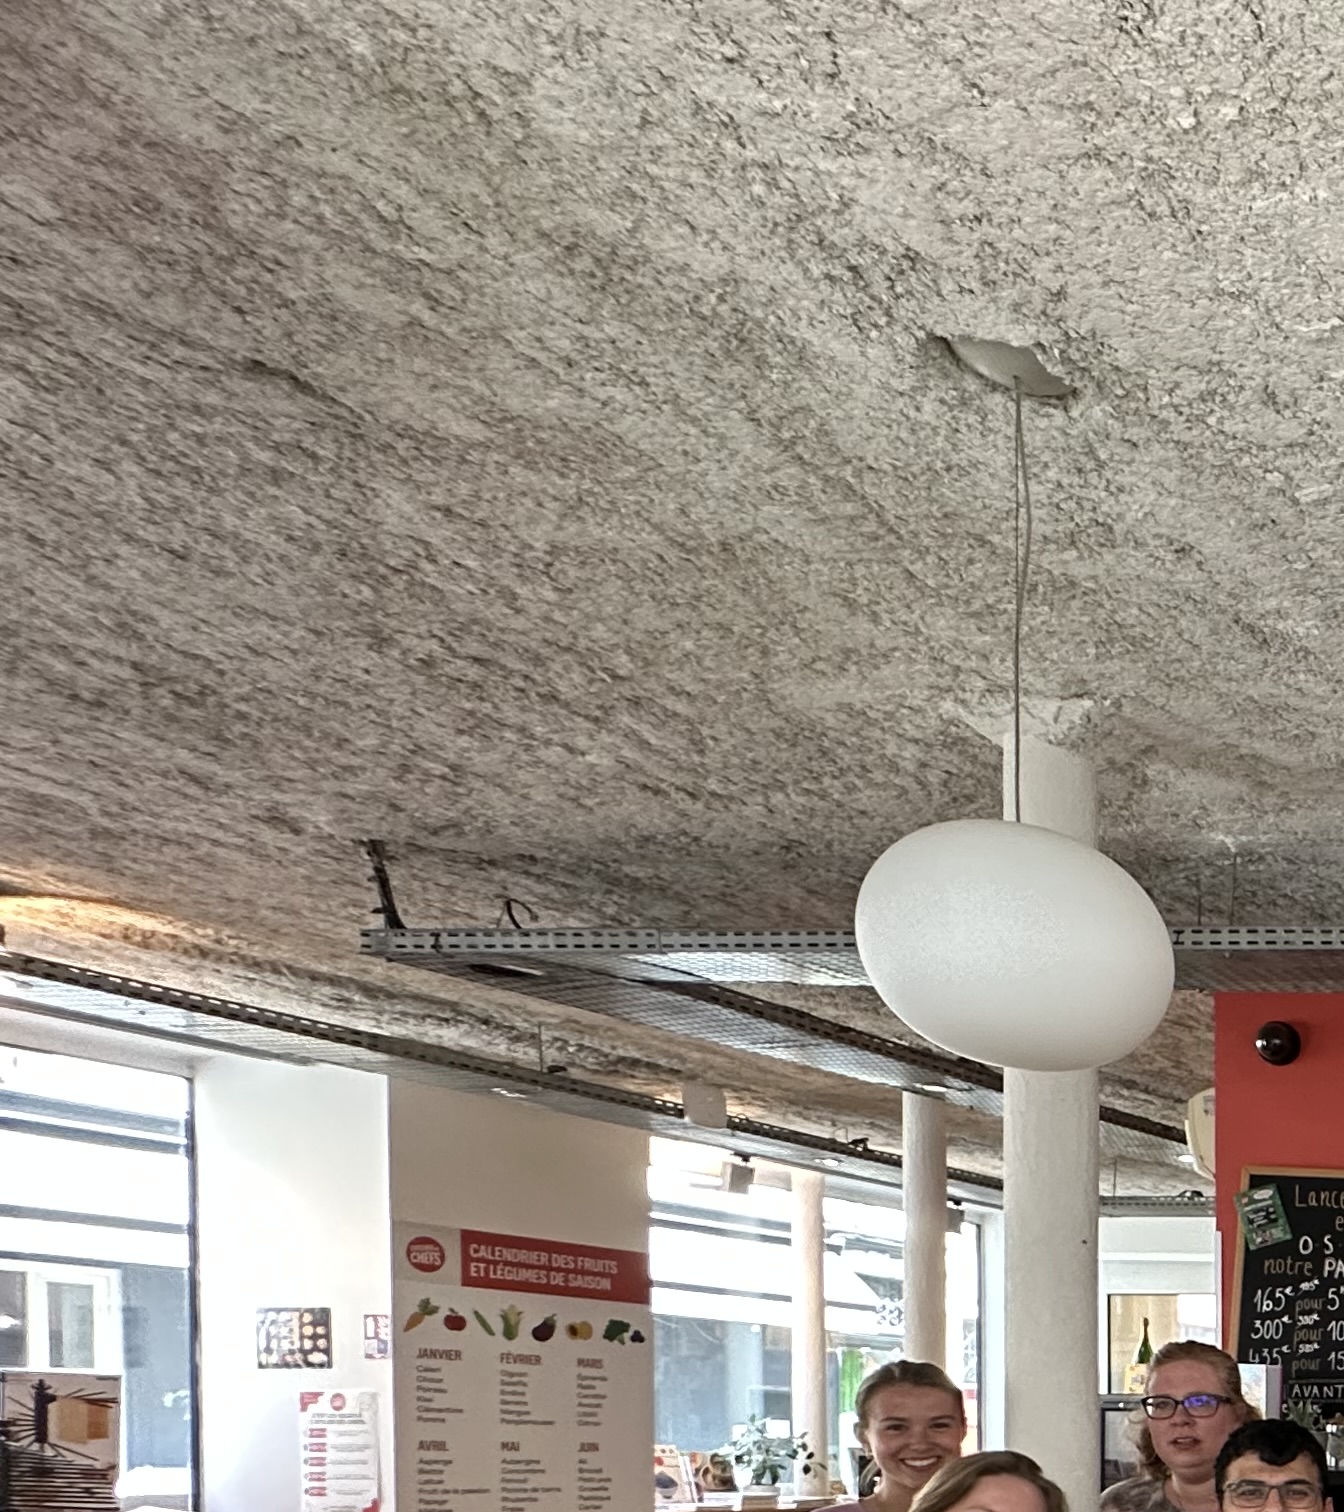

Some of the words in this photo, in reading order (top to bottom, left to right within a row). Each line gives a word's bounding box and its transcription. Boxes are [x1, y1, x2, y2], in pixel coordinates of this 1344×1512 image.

[470, 1244, 549, 1266] CALENDRIER
[551, 1253, 574, 1269] DES
[577, 1256, 618, 1274] FRUITS
[1263, 1256, 1313, 1276] notre
[470, 1263, 485, 1277] ET
[489, 1262, 548, 1284] LÉGUMES
[550, 1271, 566, 1286] DE
[568, 1273, 611, 1290] SAISON
[416, 1347, 462, 1361] JANVIER
[500, 1350, 542, 1366] FÉVRIER
[577, 1358, 603, 1369] MARS
[417, 1440, 449, 1452] AVRIL
[501, 1441, 520, 1452] MAI
